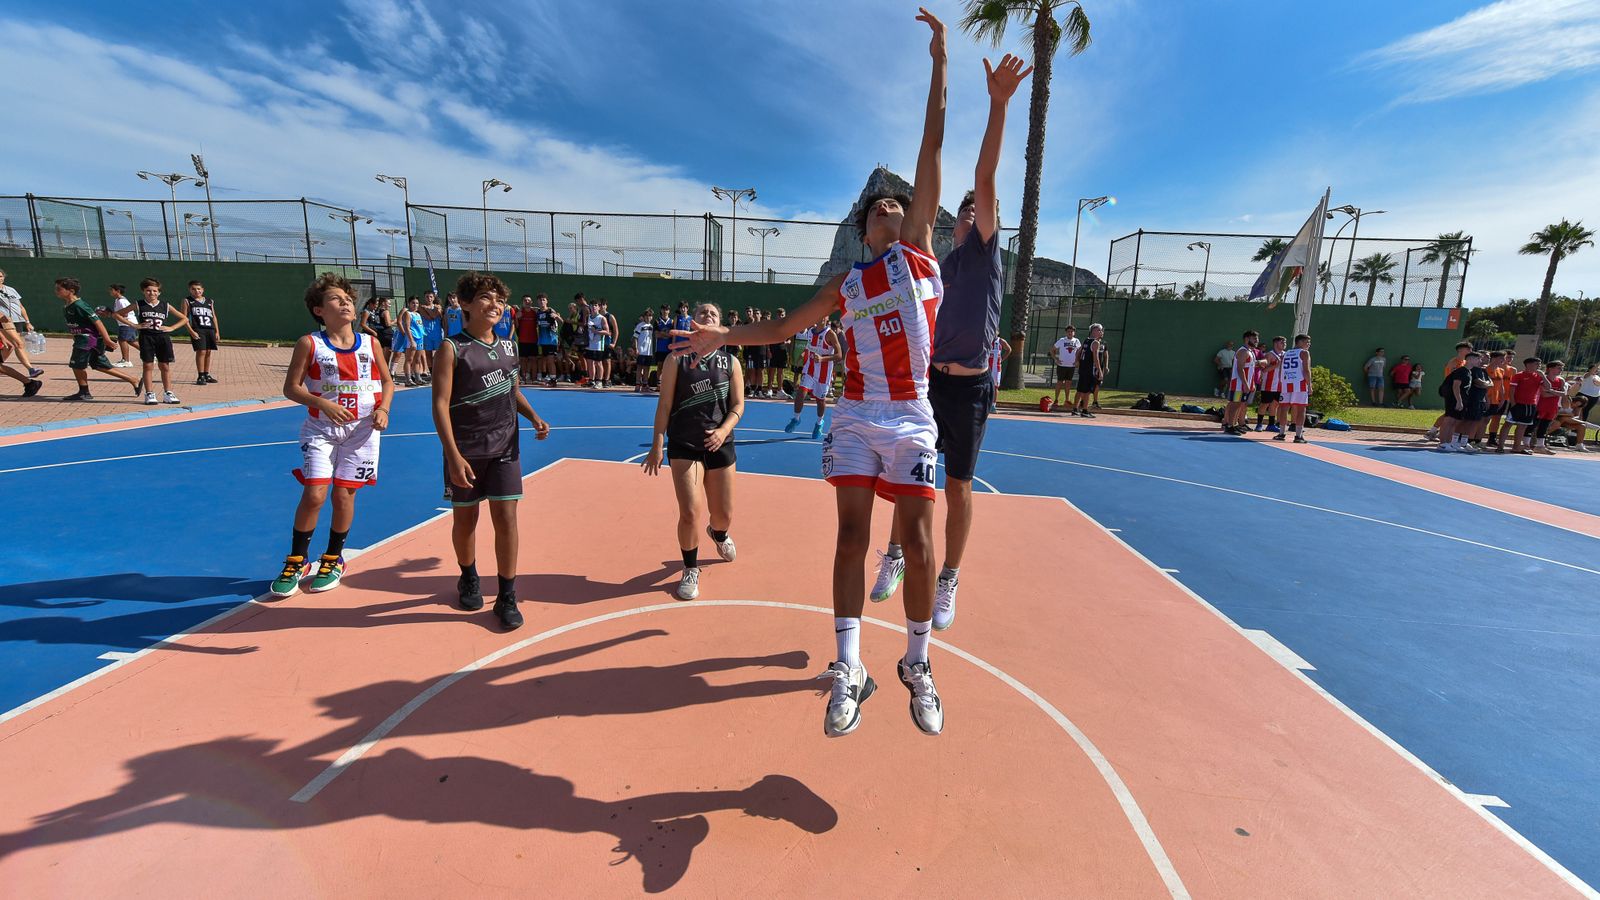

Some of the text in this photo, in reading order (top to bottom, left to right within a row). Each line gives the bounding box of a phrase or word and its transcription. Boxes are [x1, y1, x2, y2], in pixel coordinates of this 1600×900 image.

[199, 316, 212, 327] 12
[879, 318, 902, 337] 40
[716, 355, 728, 369] 33
[1283, 356, 1299, 369] 55
[481, 368, 506, 388] CADIZ
[340, 397, 356, 408] 32
[355, 467, 374, 480] 32
[911, 462, 935, 484] 40
